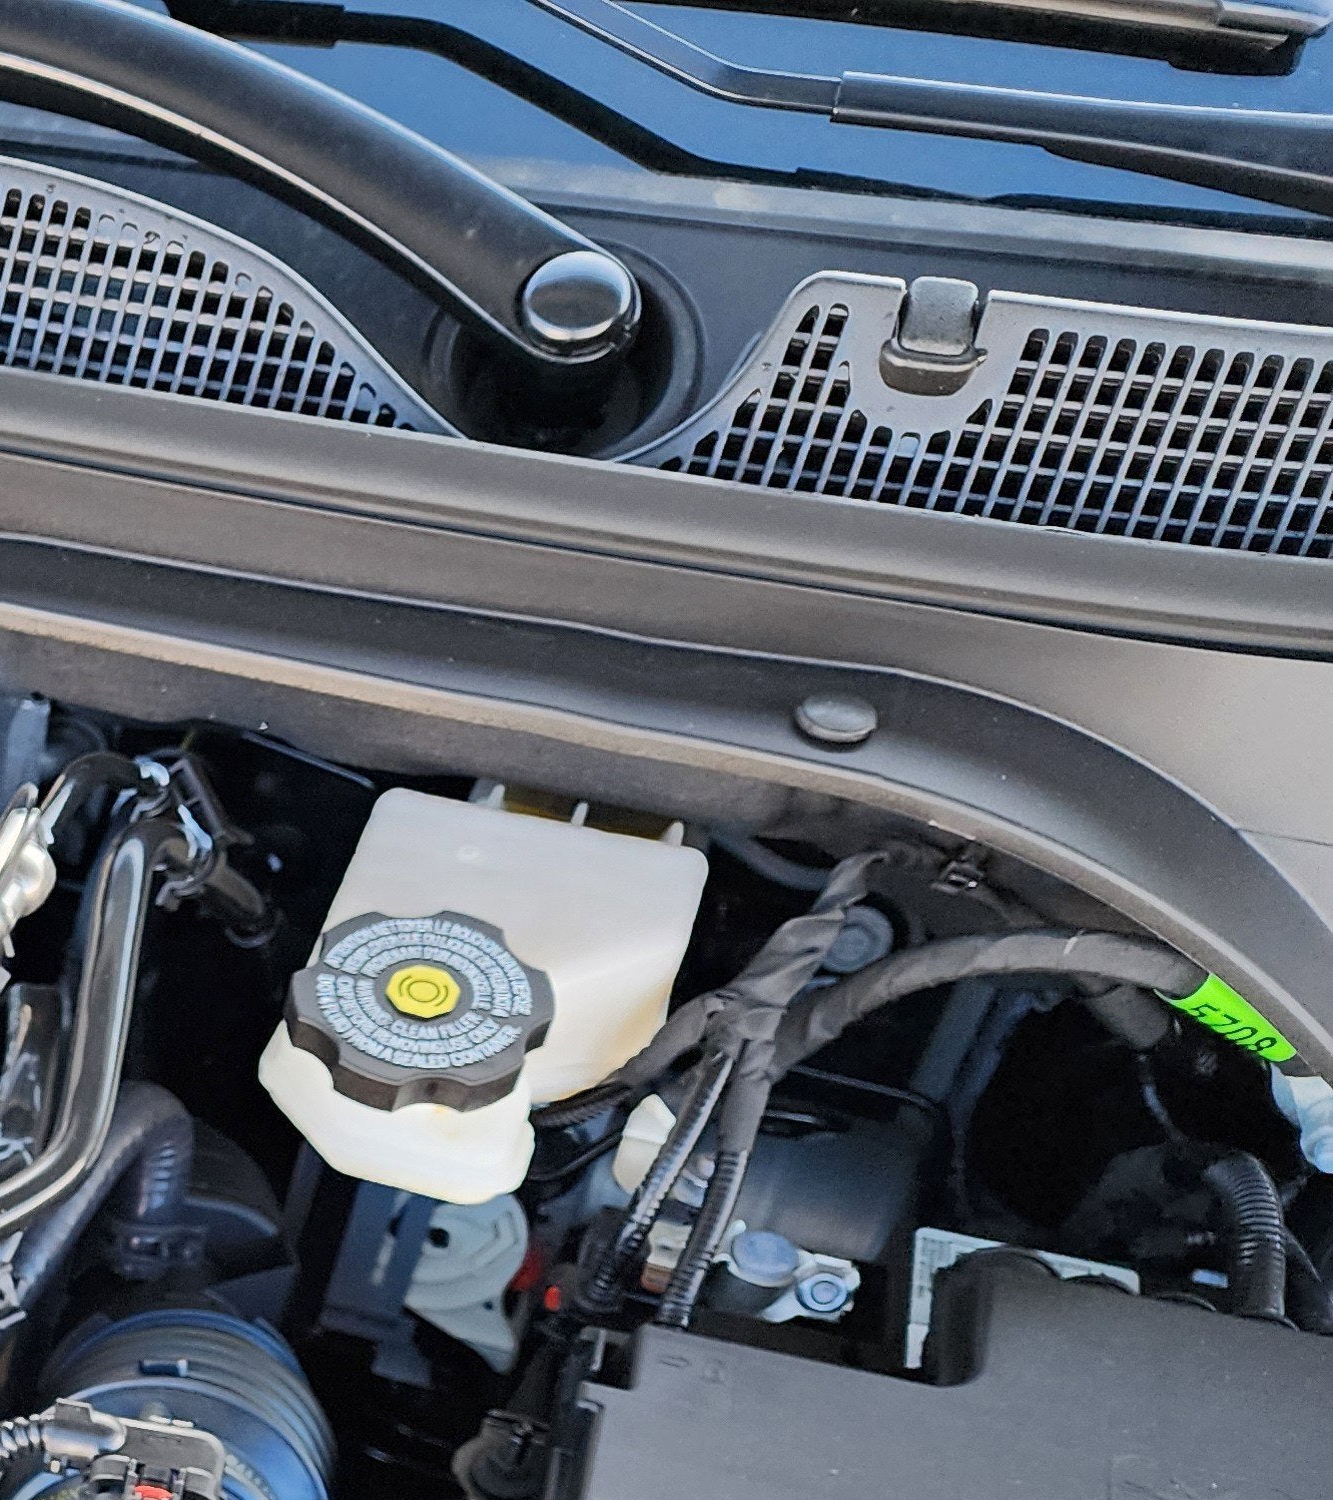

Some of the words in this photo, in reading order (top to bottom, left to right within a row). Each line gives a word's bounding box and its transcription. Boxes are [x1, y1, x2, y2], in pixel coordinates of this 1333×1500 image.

[391, 1019, 439, 1039] CLEAN
[438, 1011, 483, 1038] FILLER
[1190, 1003, 1277, 1052] 5708
